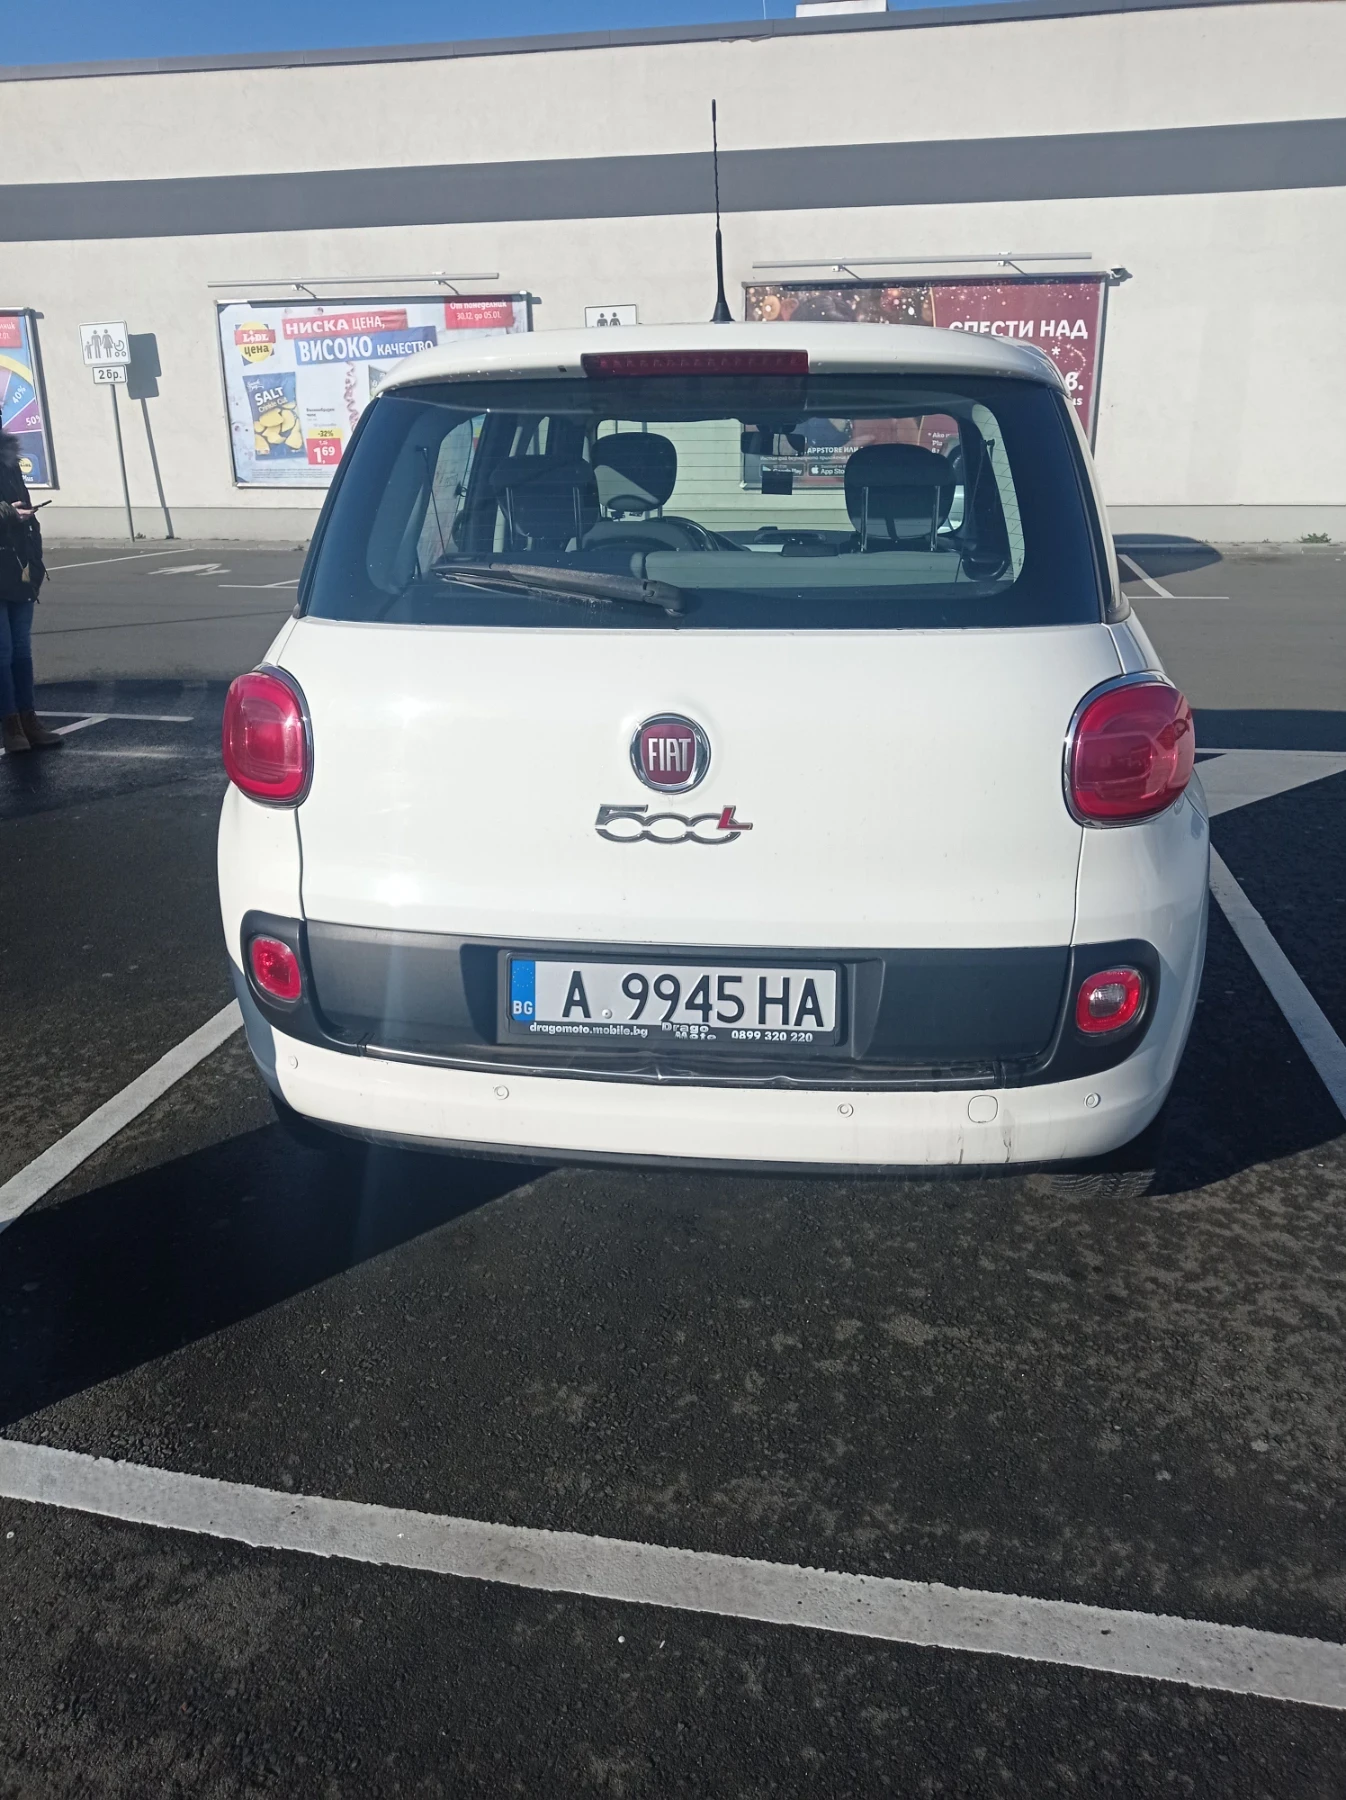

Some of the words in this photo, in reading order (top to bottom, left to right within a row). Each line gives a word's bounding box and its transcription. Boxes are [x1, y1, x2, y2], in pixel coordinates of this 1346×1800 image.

[285, 319, 348, 335] НИСКА
[352, 315, 385, 330] ЦЕНА,
[1039, 319, 1088, 340] НАД
[242, 330, 270, 343] LIDL
[243, 344, 270, 357] цена
[298, 335, 373, 362] ВИСОКО
[377, 340, 434, 356] КАЧЕСТВО
[98, 369, 105, 380] 2
[106, 368, 122, 381] бр.
[12, 385, 26, 404] 40%
[254, 386, 284, 406] SALT
[807, 446, 843, 454] APPSTORE
[648, 738, 691, 772] FIAT
[594, 804, 754, 845] 500L
[561, 970, 592, 1019] A
[512, 1000, 533, 1015] BG
[529, 1022, 648, 1037] dragomoto.mobile.bg
[661, 1022, 709, 1034] Drago
[731, 1030, 761, 1041] 0899
[764, 1031, 787, 1042] 320
[790, 1032, 814, 1043] 220
